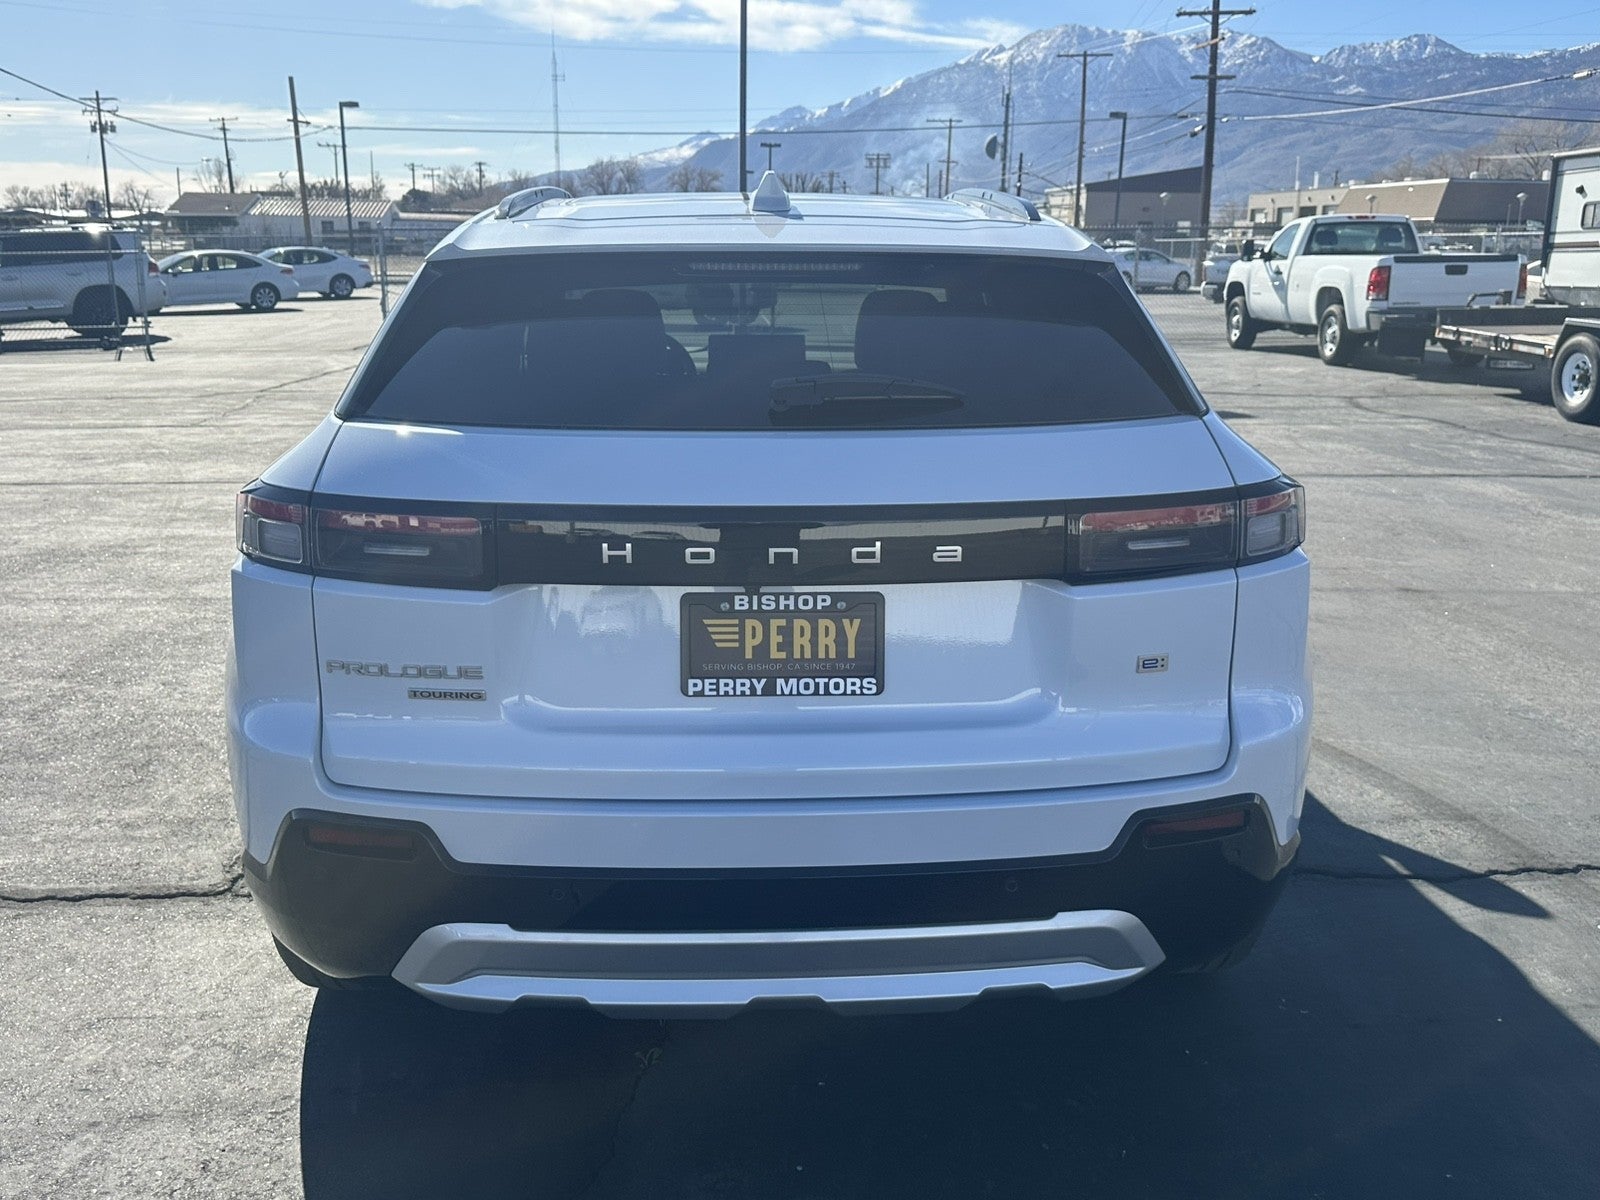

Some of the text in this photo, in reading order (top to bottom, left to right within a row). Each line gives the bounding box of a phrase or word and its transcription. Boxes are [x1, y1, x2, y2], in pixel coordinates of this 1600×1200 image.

[602, 542, 962, 564] Honda
[734, 595, 831, 610] BISHOP
[745, 618, 861, 659] PERRY
[326, 660, 484, 680] PROLOGUE
[702, 663, 743, 671] SERVING
[788, 663, 800, 671] CA
[804, 662, 831, 671] SINCE
[835, 662, 856, 671] 1947
[410, 689, 483, 700] TOURING
[688, 678, 877, 696] PERRY MOTORS
